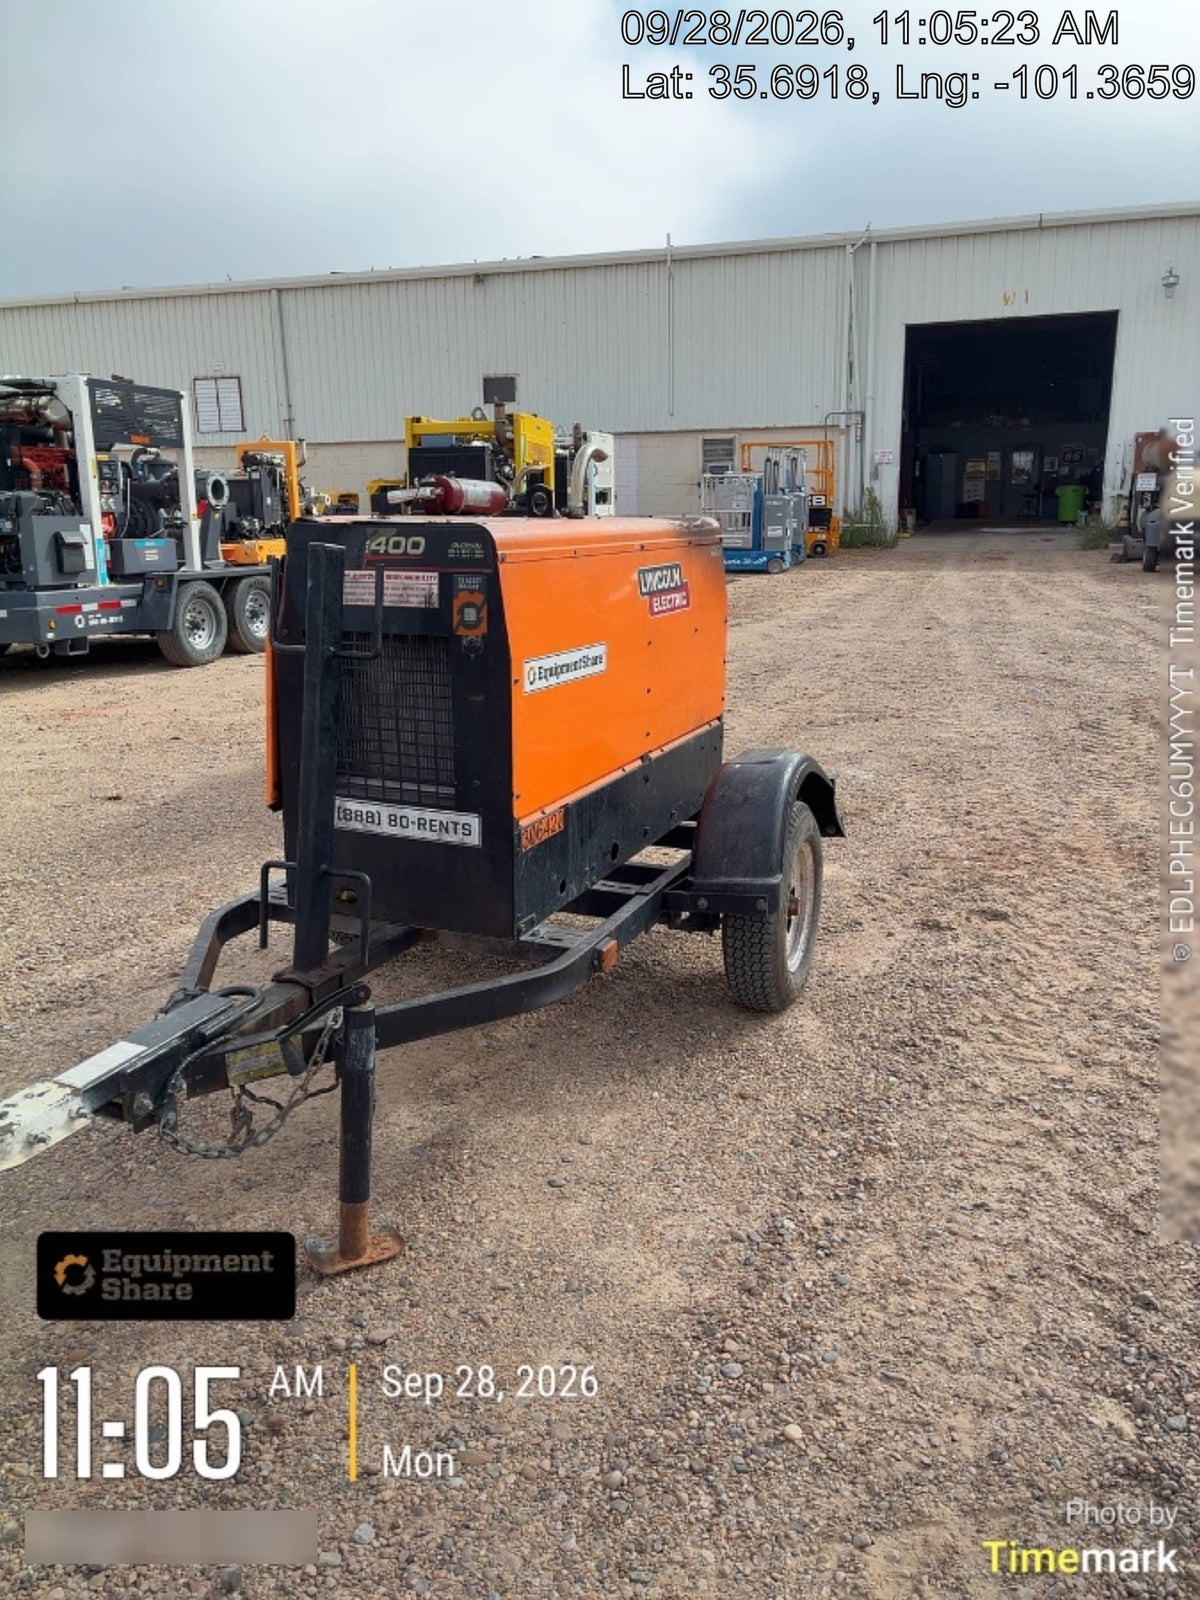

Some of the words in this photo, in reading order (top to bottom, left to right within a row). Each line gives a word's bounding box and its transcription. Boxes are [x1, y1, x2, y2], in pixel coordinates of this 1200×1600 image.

[639, 566, 682, 593] LINCOLN
[652, 591, 688, 612] ELECTRIC
[537, 654, 604, 682] EquipmentShare
[336, 806, 381, 826] (888)
[388, 813, 472, 837] 80-RENTS
